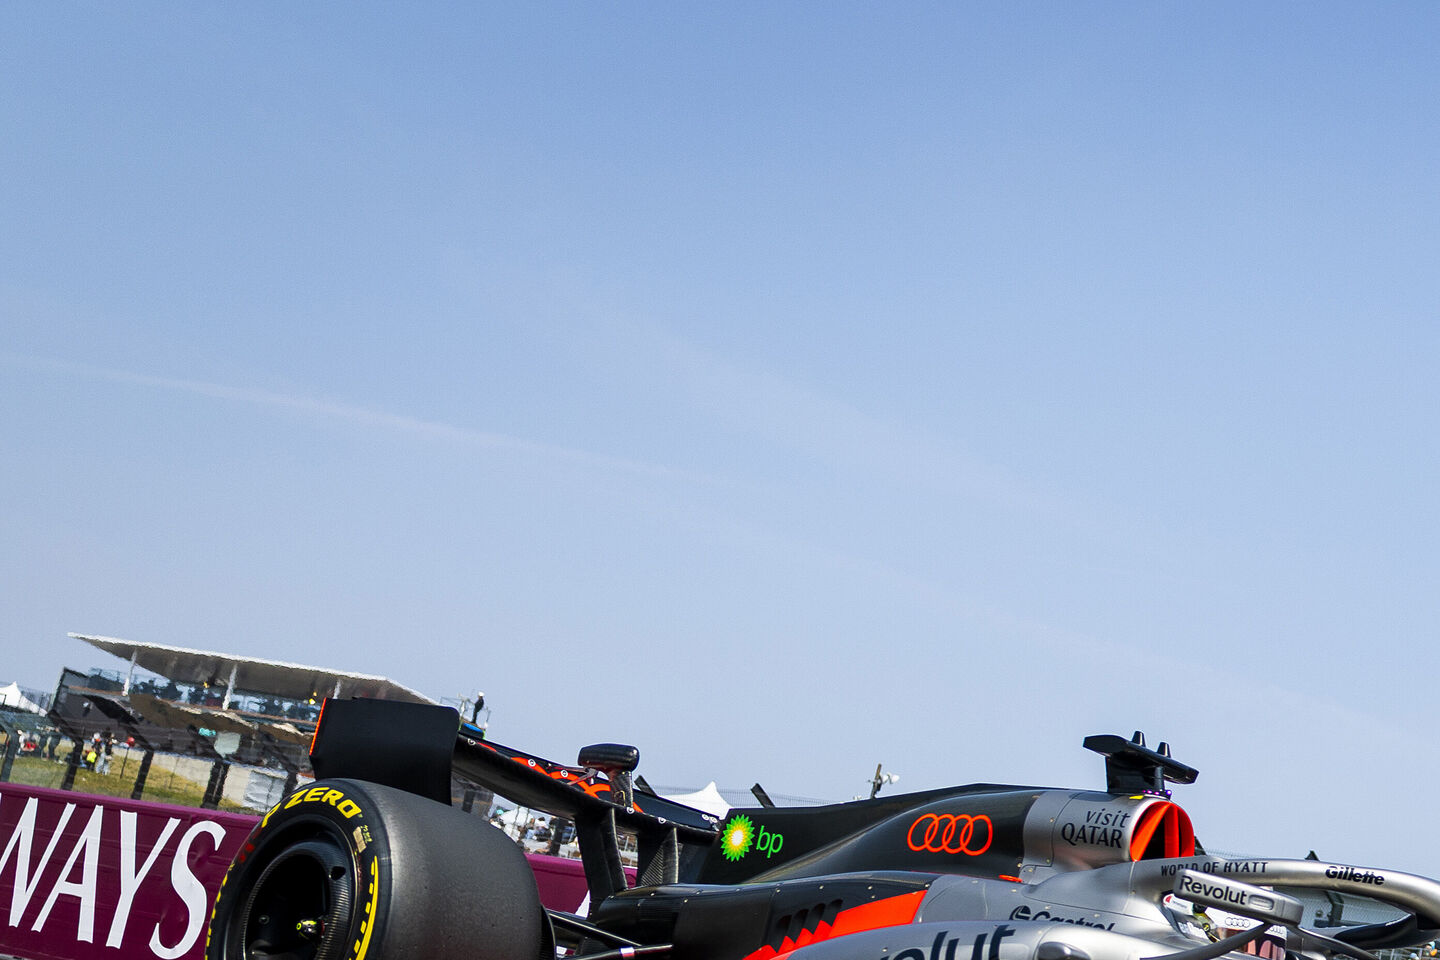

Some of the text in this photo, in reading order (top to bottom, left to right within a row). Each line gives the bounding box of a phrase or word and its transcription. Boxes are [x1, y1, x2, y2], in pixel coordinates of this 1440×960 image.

[284, 787, 362, 819] ZERO
[1086, 808, 1130, 829] visit
[756, 825, 784, 858] bp
[1061, 822, 1123, 849] QATAR
[1203, 861, 1220, 874] OF
[1223, 860, 1269, 874] HYATT
[1325, 865, 1385, 885] Gillette
[1179, 875, 1249, 905] Revolut
